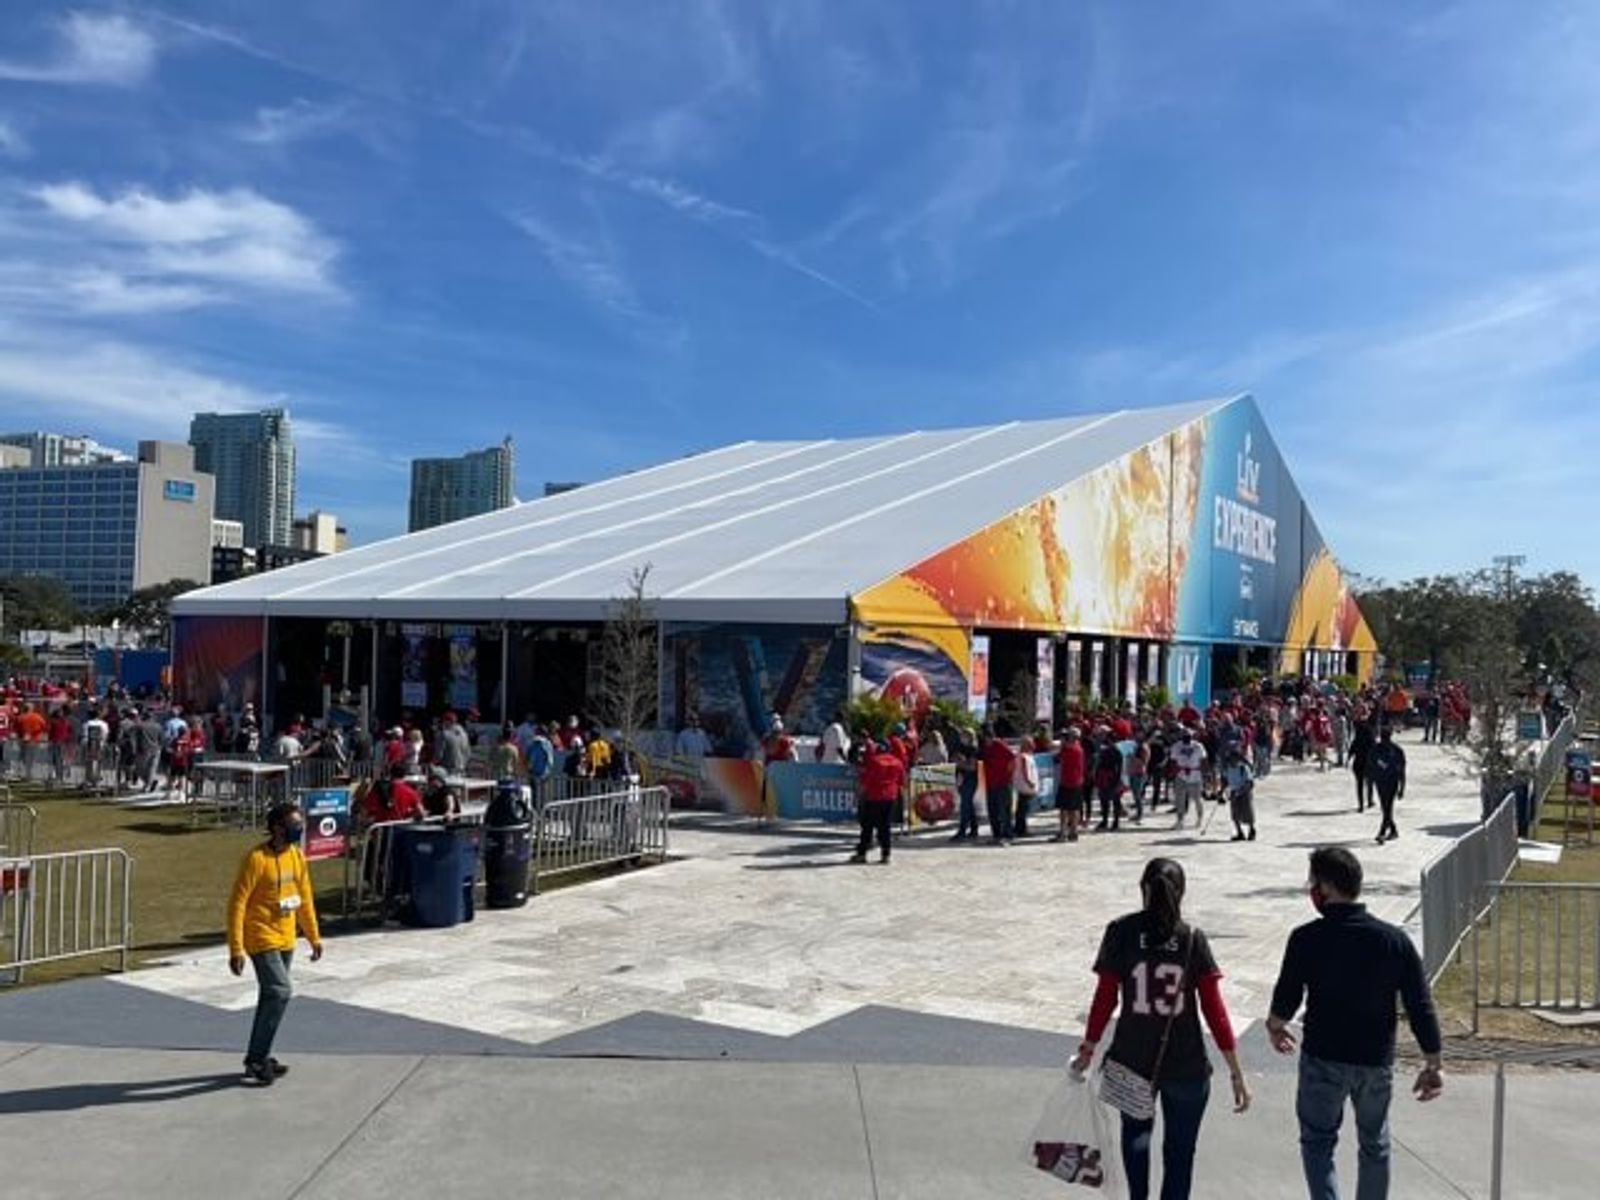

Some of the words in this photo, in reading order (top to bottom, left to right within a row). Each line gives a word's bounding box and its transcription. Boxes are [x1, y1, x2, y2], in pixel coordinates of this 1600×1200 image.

[1214, 495, 1276, 564] EXPERIENCE
[1178, 653, 1199, 694] LV
[802, 789, 859, 812] GALLER
[1132, 961, 1184, 1016] 13
